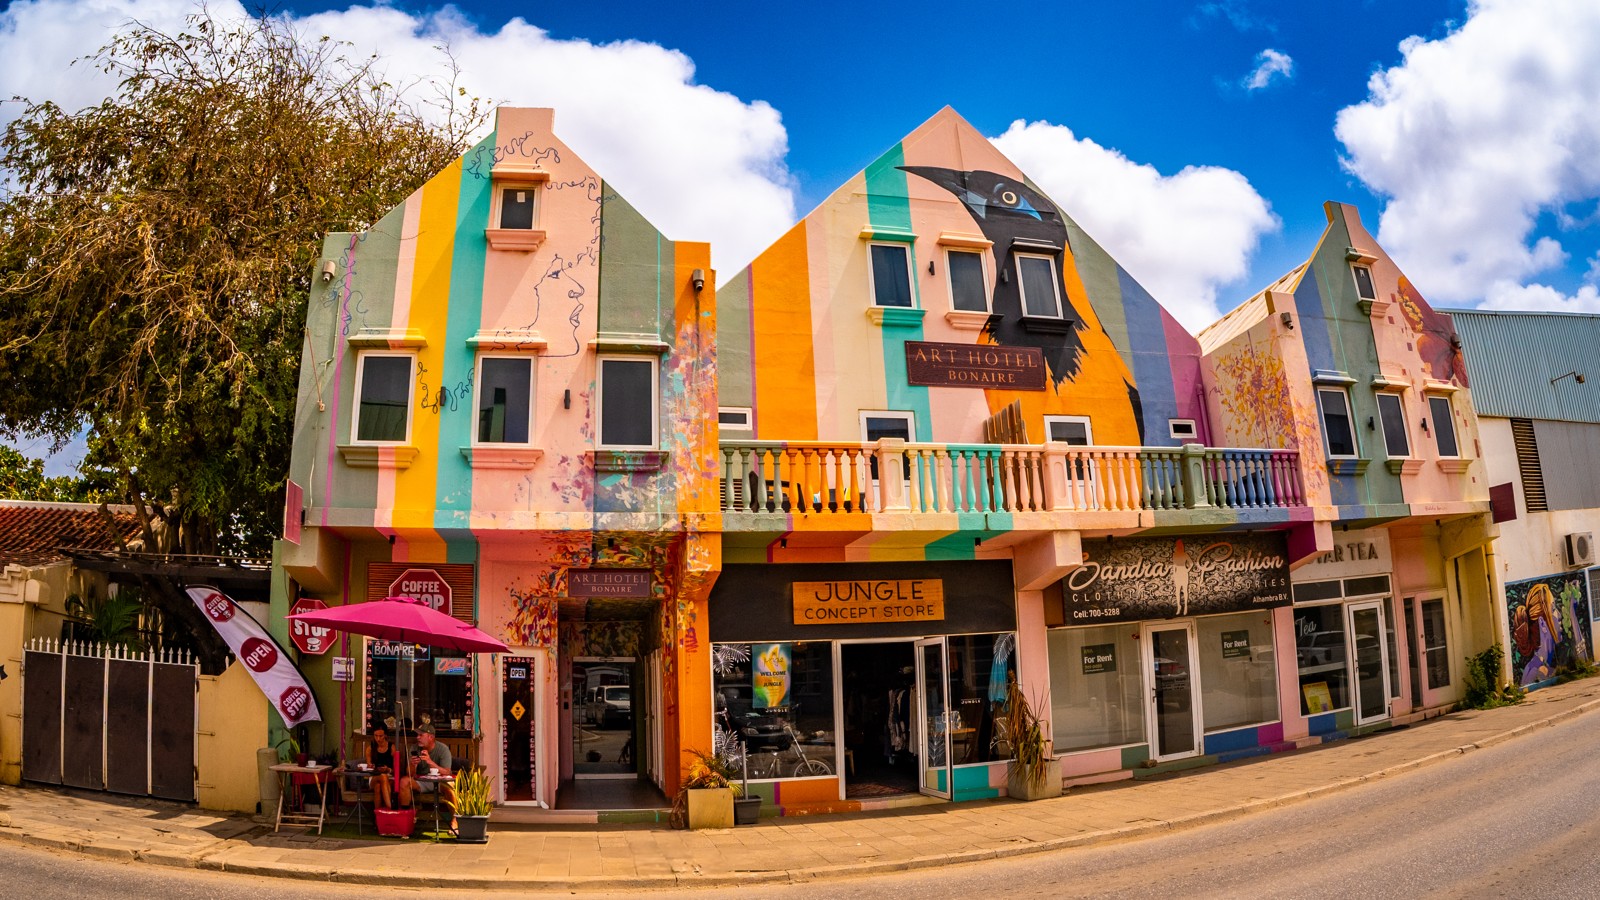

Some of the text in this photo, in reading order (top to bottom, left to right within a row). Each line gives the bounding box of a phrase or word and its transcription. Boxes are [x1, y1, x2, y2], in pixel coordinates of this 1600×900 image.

[915, 348, 1038, 367] ART HOTEL
[948, 370, 1016, 383] BONAIRE
[1347, 542, 1378, 561] TEA
[1068, 542, 1284, 590] Sandra Fashion
[401, 580, 440, 593] COFFEE
[573, 574, 647, 583] ART HOTEL
[815, 581, 924, 602] JUNGLE
[1253, 594, 1278, 603] Alhambra
[210, 600, 229, 618] STOP
[399, 593, 445, 611] OP
[804, 604, 935, 620] CONCEPT STORE
[1073, 608, 1120, 618] Cell: 700-5288
[1295, 616, 1317, 637] Tea
[246, 642, 272, 667] OPEN
[374, 645, 415, 656] BONARE
[1084, 653, 1112, 664] For Rent
[511, 669, 525, 677] OPEN
[282, 688, 301, 707] COFFEE
[287, 692, 307, 716] STOP
